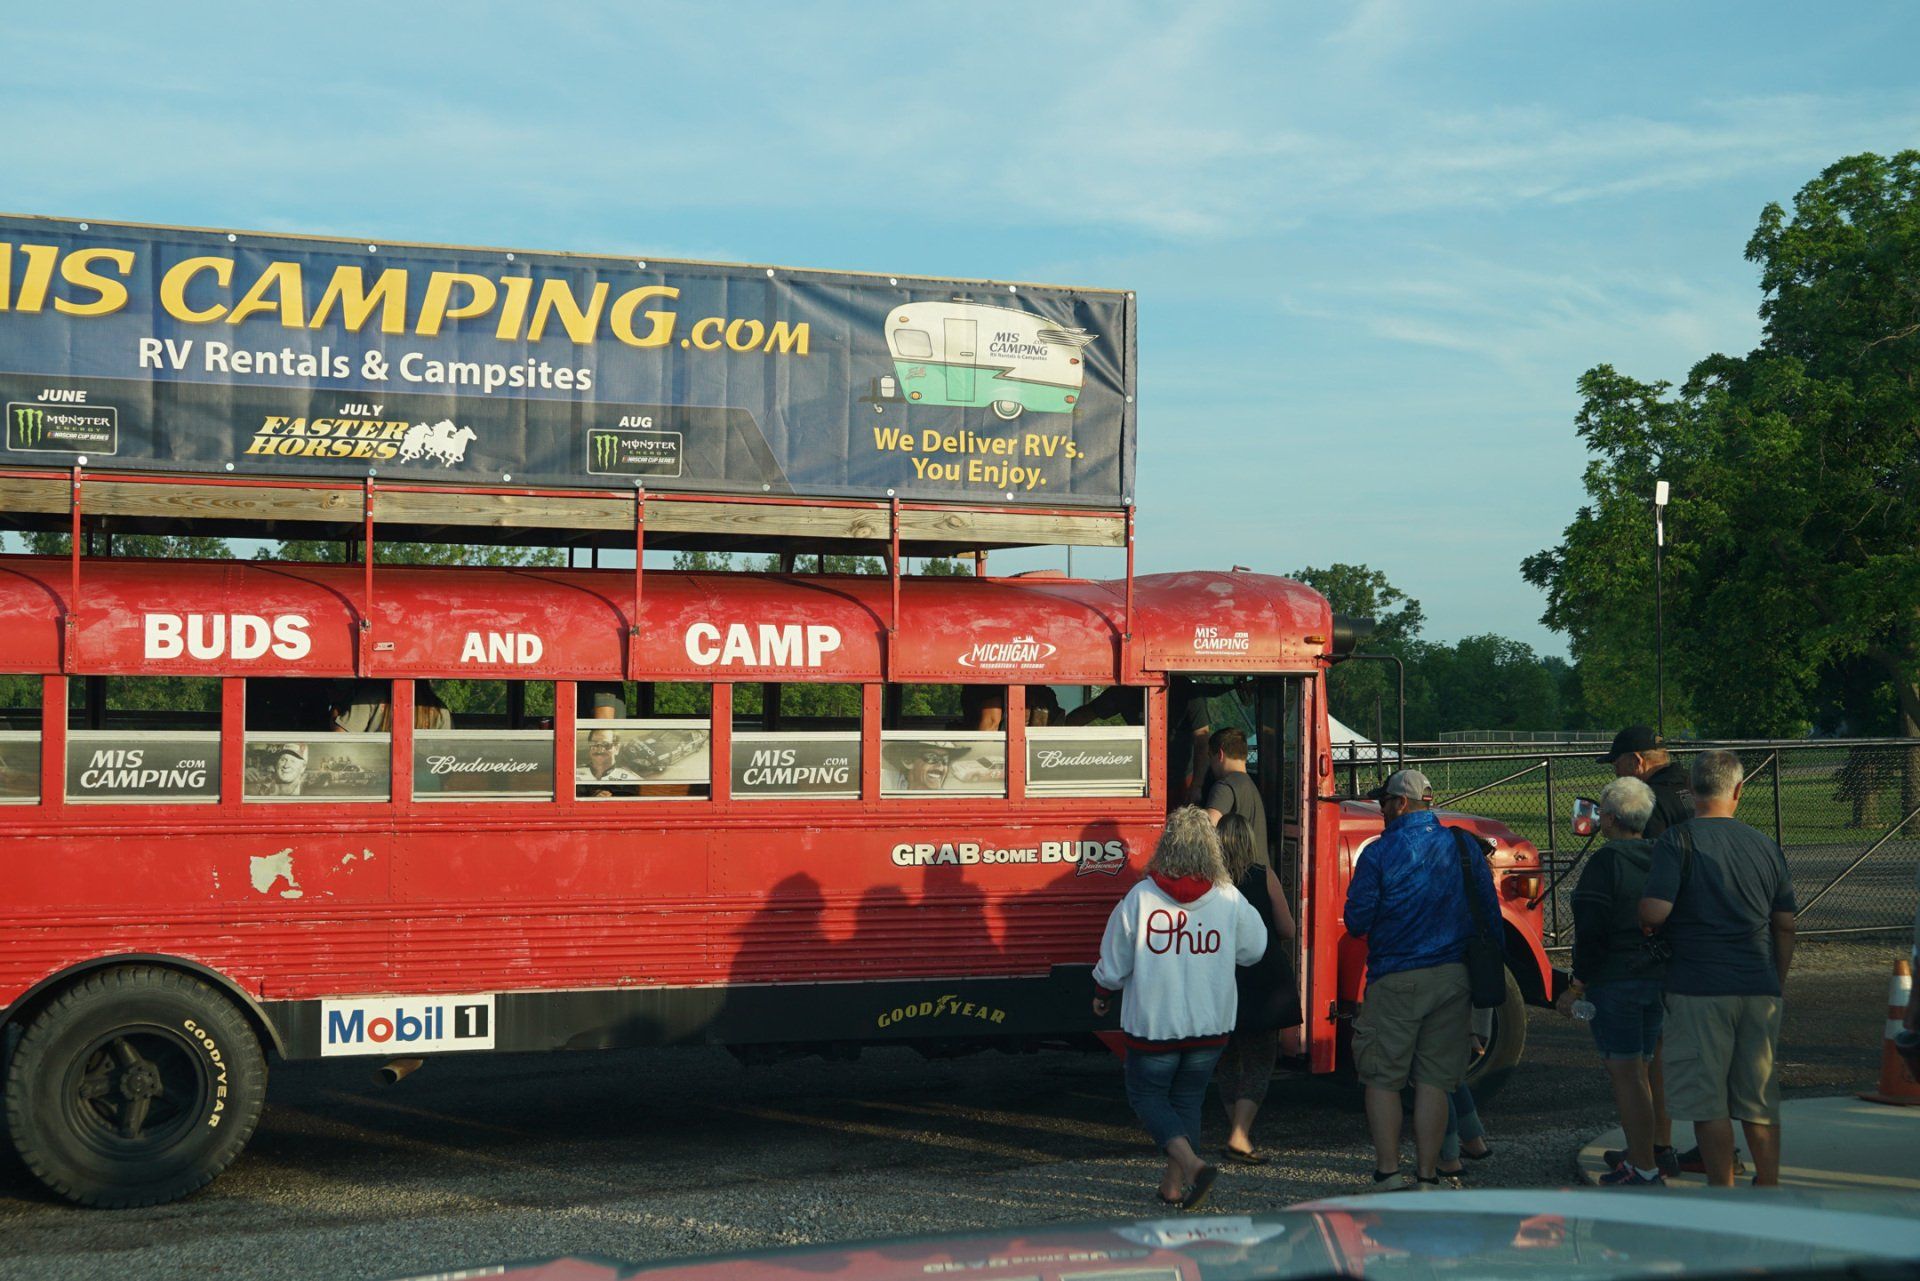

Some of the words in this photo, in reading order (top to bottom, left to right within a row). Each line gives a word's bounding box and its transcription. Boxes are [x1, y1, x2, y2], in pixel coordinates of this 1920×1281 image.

[0, 243, 135, 315] IS
[994, 332, 1020, 343] MIS
[989, 342, 1048, 355] CAMPING
[138, 337, 192, 370] RV
[205, 340, 350, 380] Rentals
[360, 351, 390, 380] &
[400, 352, 592, 392] Campsites
[37, 389, 87, 402] JUNE
[46, 414, 111, 426] MONSTER
[339, 403, 384, 417] JULY
[257, 416, 411, 440] FASTER
[619, 416, 652, 428] AUG
[243, 436, 402, 458] HORSES
[621, 439, 676, 450] MONSTER
[874, 427, 914, 452] We
[922, 431, 1017, 456] Deliver
[911, 457, 959, 482] You
[968, 461, 1047, 490] Enjoy.
[144, 613, 312, 661] BUDS
[1194, 627, 1218, 638] MIS
[460, 632, 543, 664] AND
[685, 623, 842, 668] CAMP
[971, 643, 1040, 662] MICHIGAN
[1193, 638, 1249, 650] CAMPING
[89, 749, 144, 768] MIS
[176, 759, 206, 769] .COM
[426, 754, 539, 776] Budweiser
[750, 749, 795, 766] MIS
[823, 757, 848, 766] .COM
[1036, 749, 1134, 769] Budweiser
[80, 769, 207, 789] CAMPING
[743, 766, 849, 785] CAMPING
[891, 842, 980, 866] GRAB
[982, 849, 1038, 863] SOME
[1041, 840, 1123, 863] BUDS
[1146, 909, 1221, 955] Ohio
[877, 995, 1006, 1028] GOODYEAR
[328, 1006, 443, 1044] Mobil
[464, 1007, 477, 1036] 1
[183, 1018, 228, 1128] GOODYEAR
